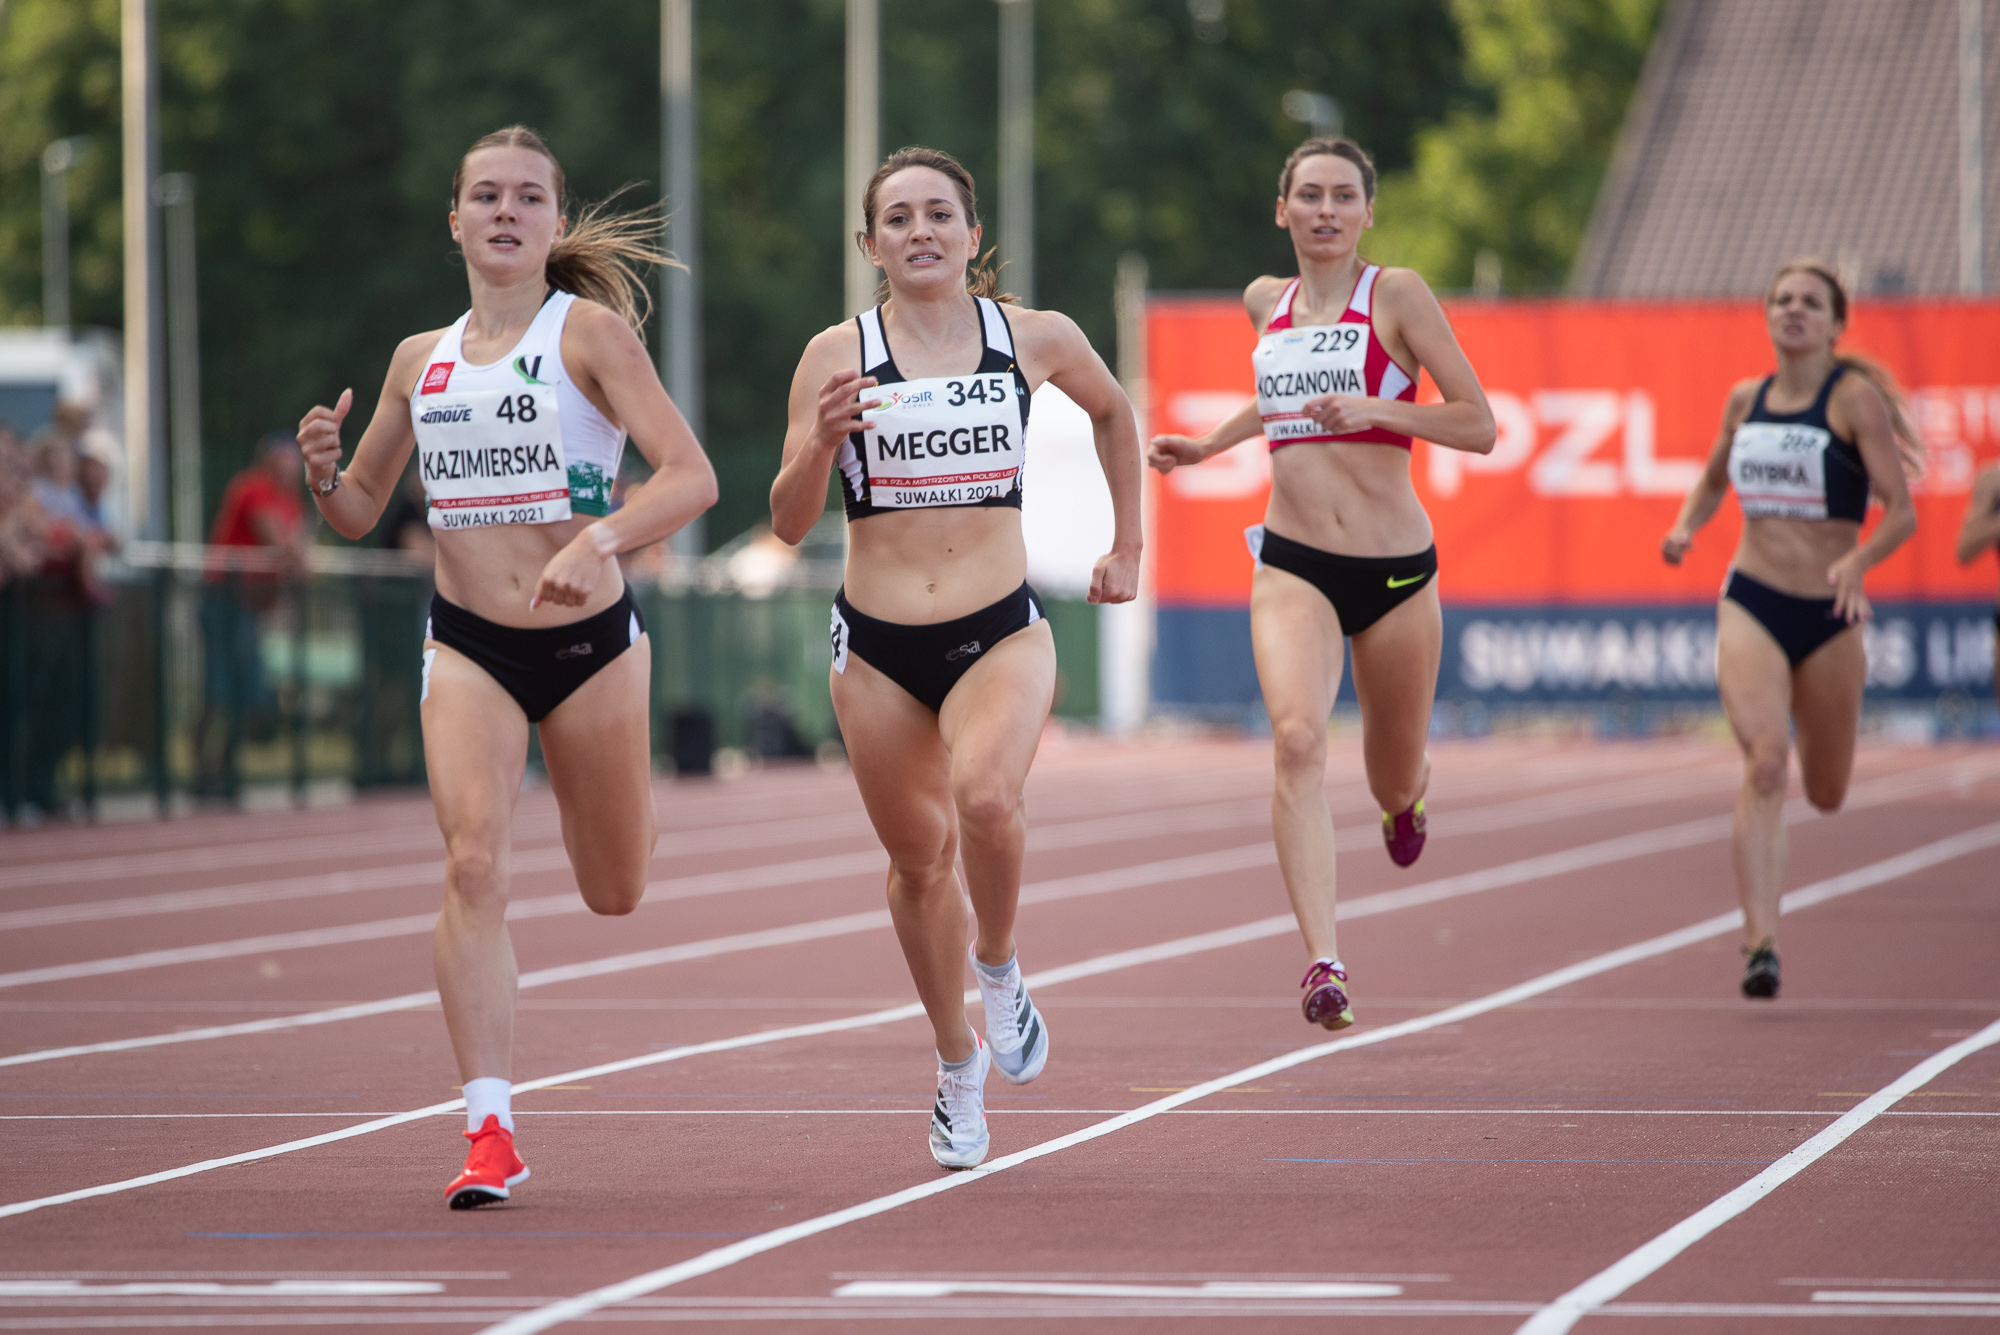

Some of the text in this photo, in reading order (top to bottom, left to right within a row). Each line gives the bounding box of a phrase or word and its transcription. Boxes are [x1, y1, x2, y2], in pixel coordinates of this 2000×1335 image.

[1311, 329, 1360, 354] 229
[946, 379, 1006, 407] 345
[1258, 368, 1361, 399] KOCZANOWA
[496, 394, 538, 424] 48
[900, 391, 933, 404] OSIR
[420, 408, 473, 424] 4MOVE
[877, 424, 1012, 461] MEGGER
[423, 444, 560, 481] KAZIMIERSKA
[912, 475, 971, 486] MISTRZOSTWA
[973, 472, 1002, 481] POLSKI
[895, 484, 1000, 505] SUWAŁKI 2021
[442, 506, 544, 528] SUWAŁKI 2021
